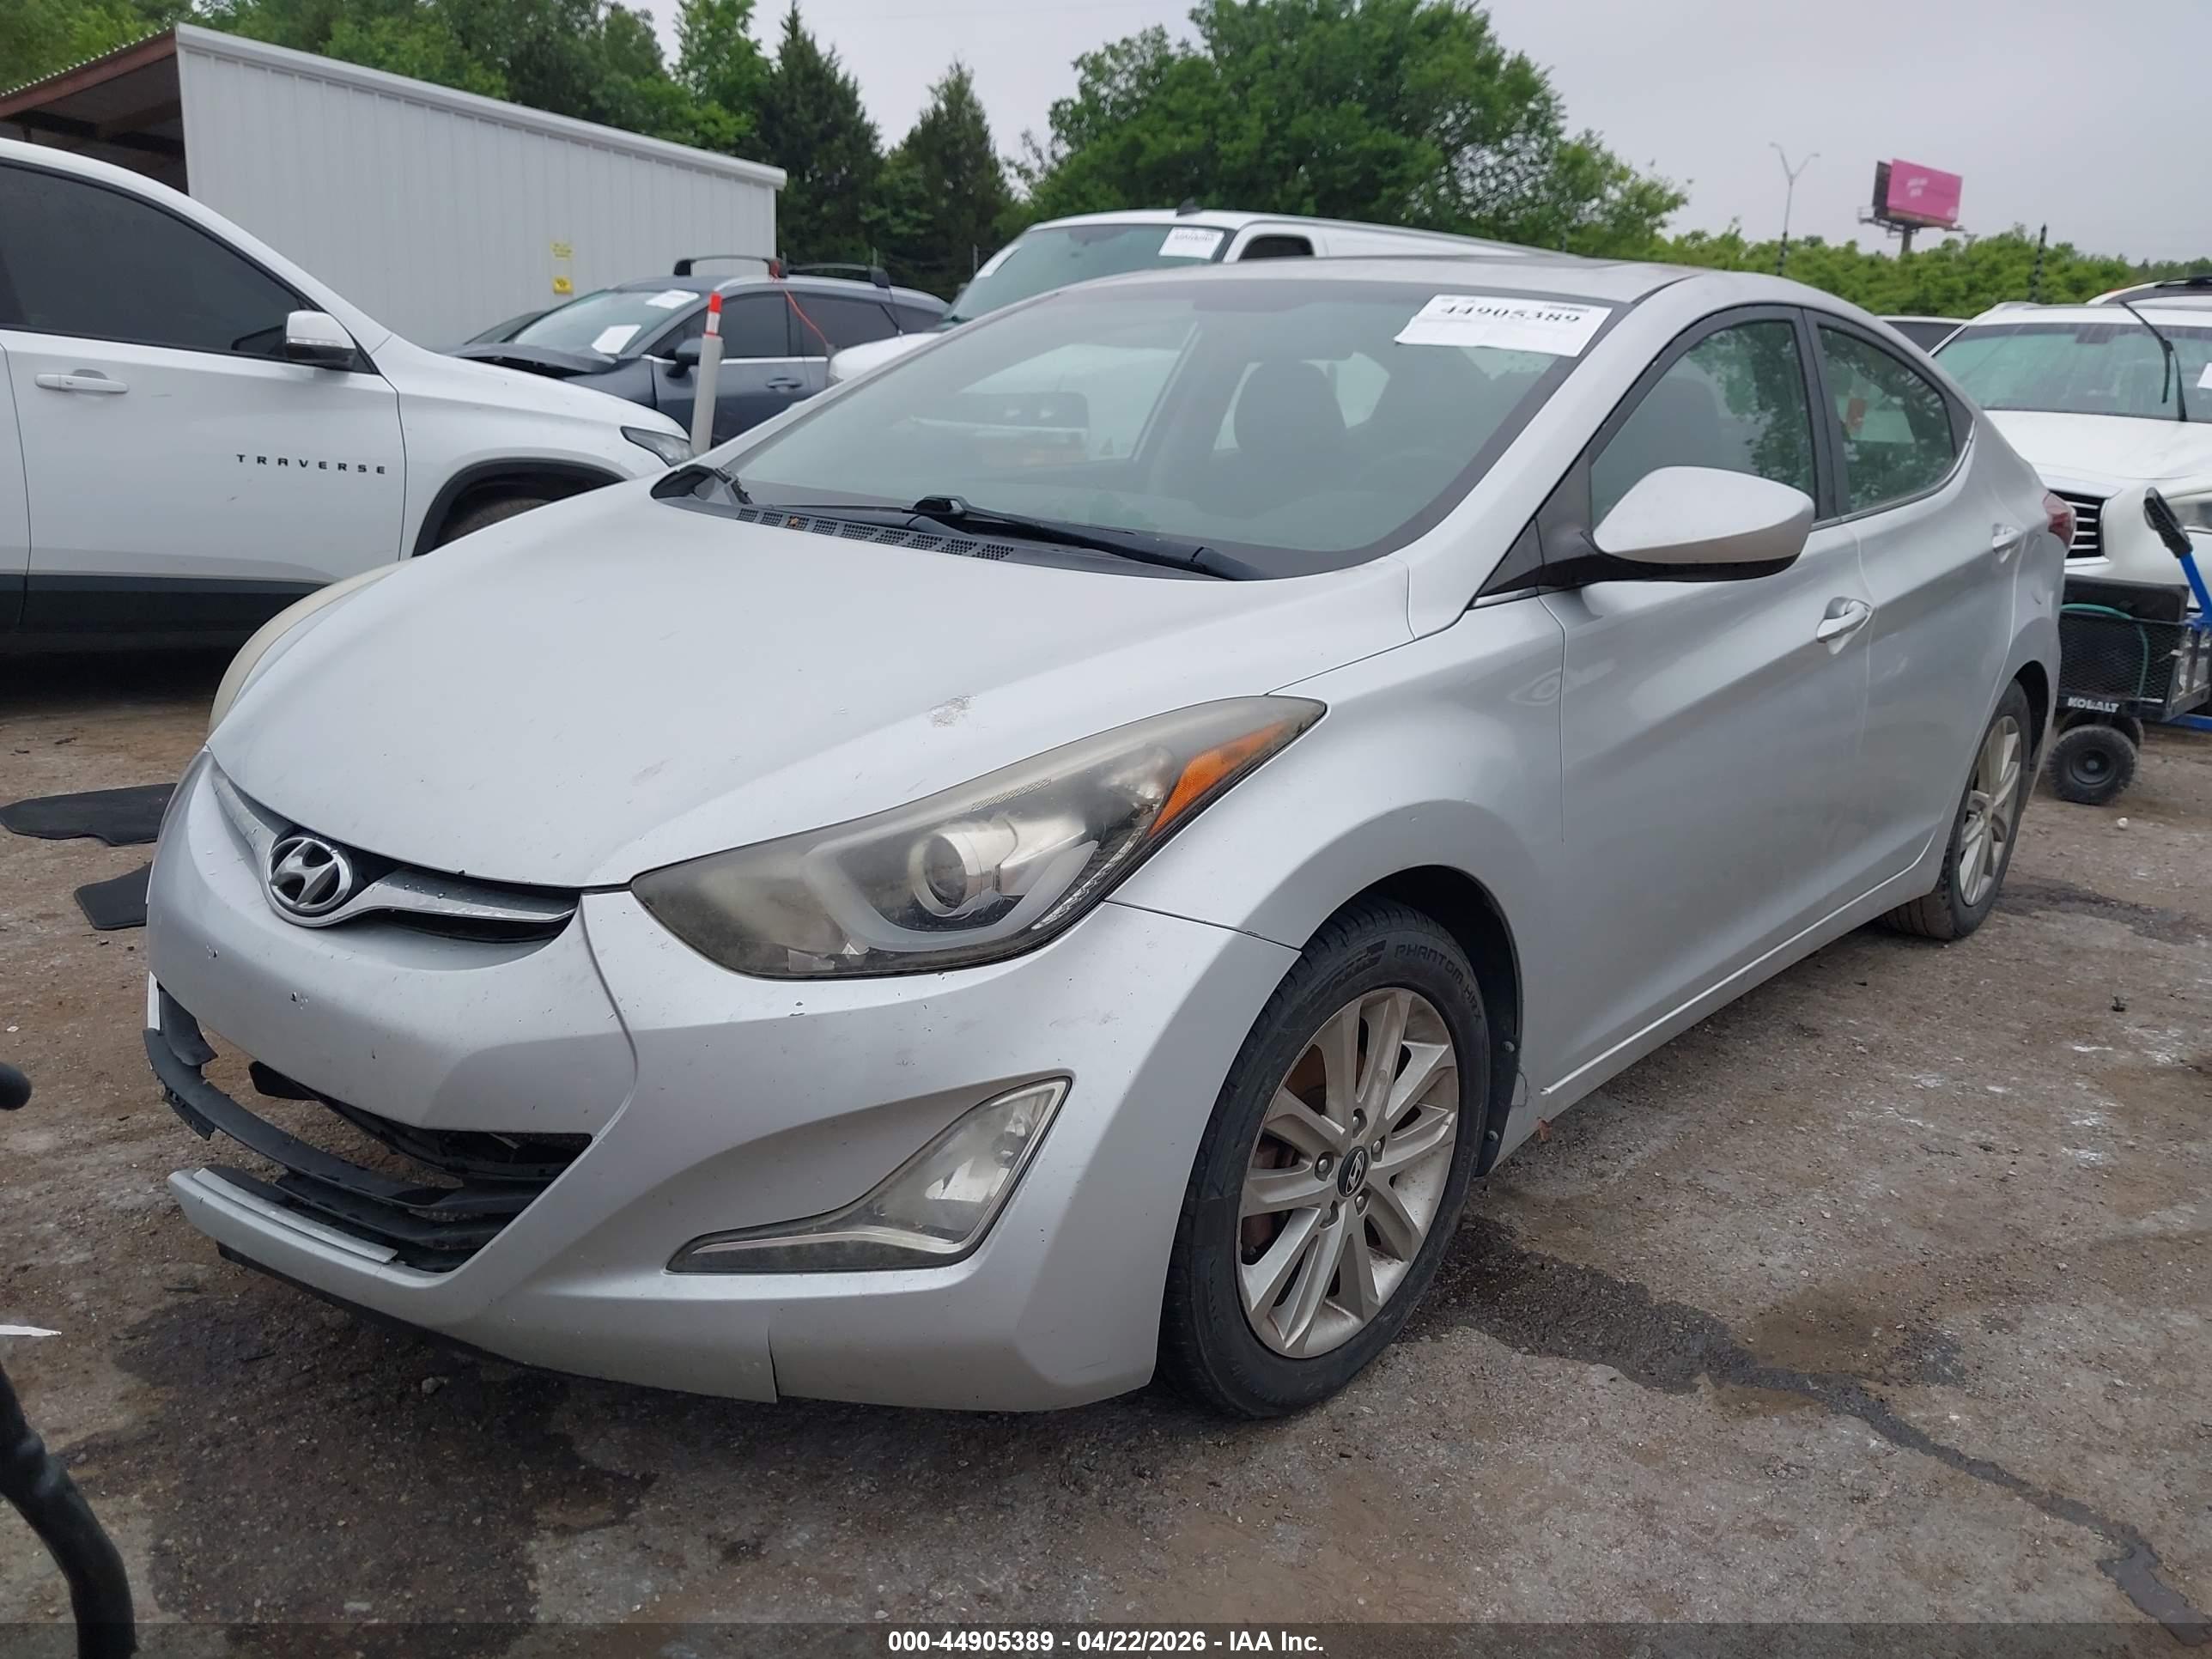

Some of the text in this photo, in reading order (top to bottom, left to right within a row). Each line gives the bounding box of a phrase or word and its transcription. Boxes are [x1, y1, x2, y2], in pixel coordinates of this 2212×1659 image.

[236, 453, 386, 475] TRAVERSE
[2067, 696, 2119, 714] KOBALT
[1394, 944, 1464, 984] PHANTOM
